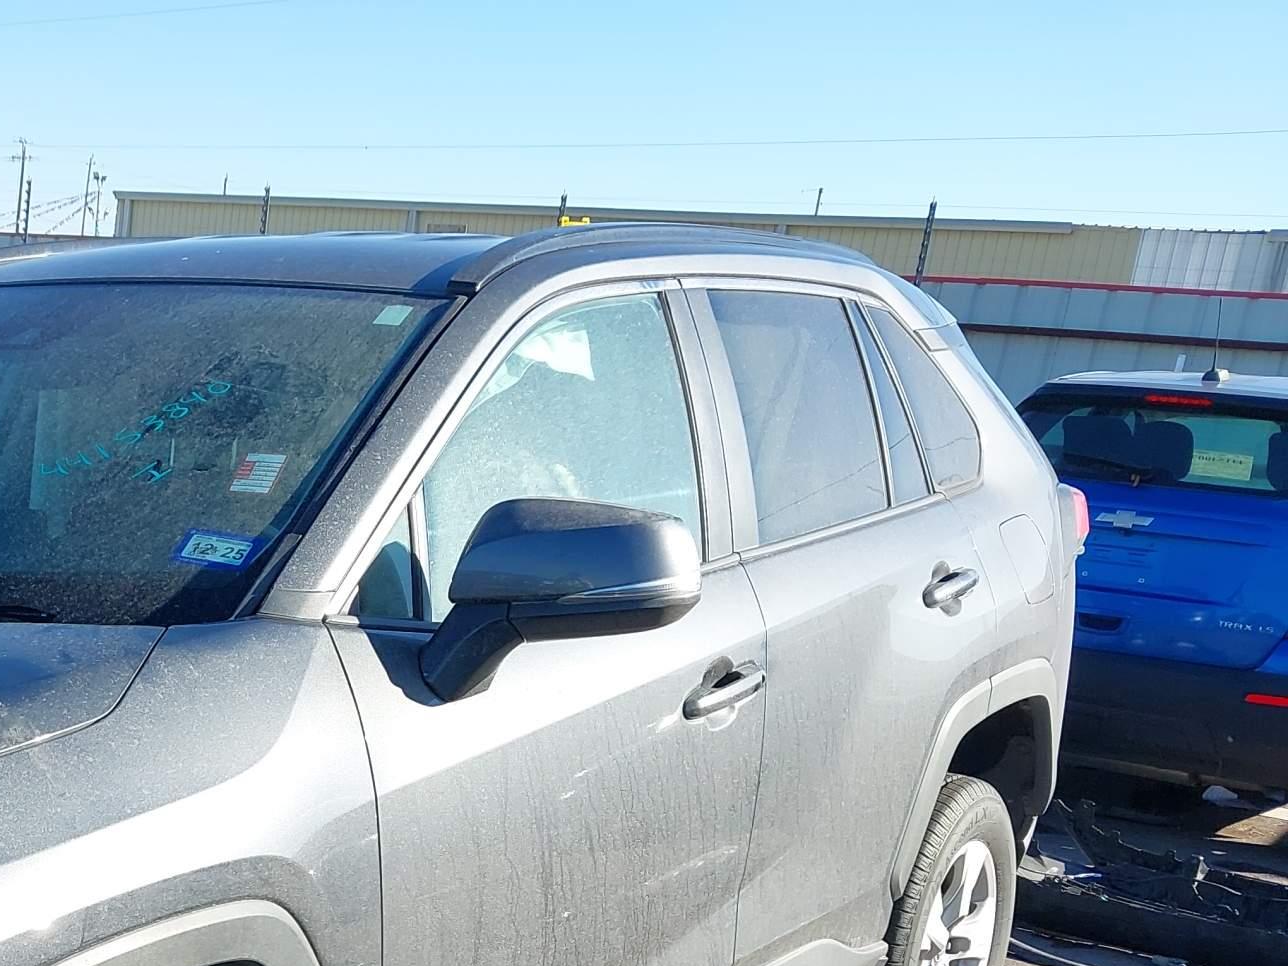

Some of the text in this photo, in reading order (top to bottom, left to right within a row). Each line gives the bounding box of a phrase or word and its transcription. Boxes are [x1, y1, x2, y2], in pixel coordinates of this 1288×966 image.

[39, 379, 233, 476] 44153840
[220, 546, 248, 561] 25
[1218, 620, 1253, 632] TRAX
